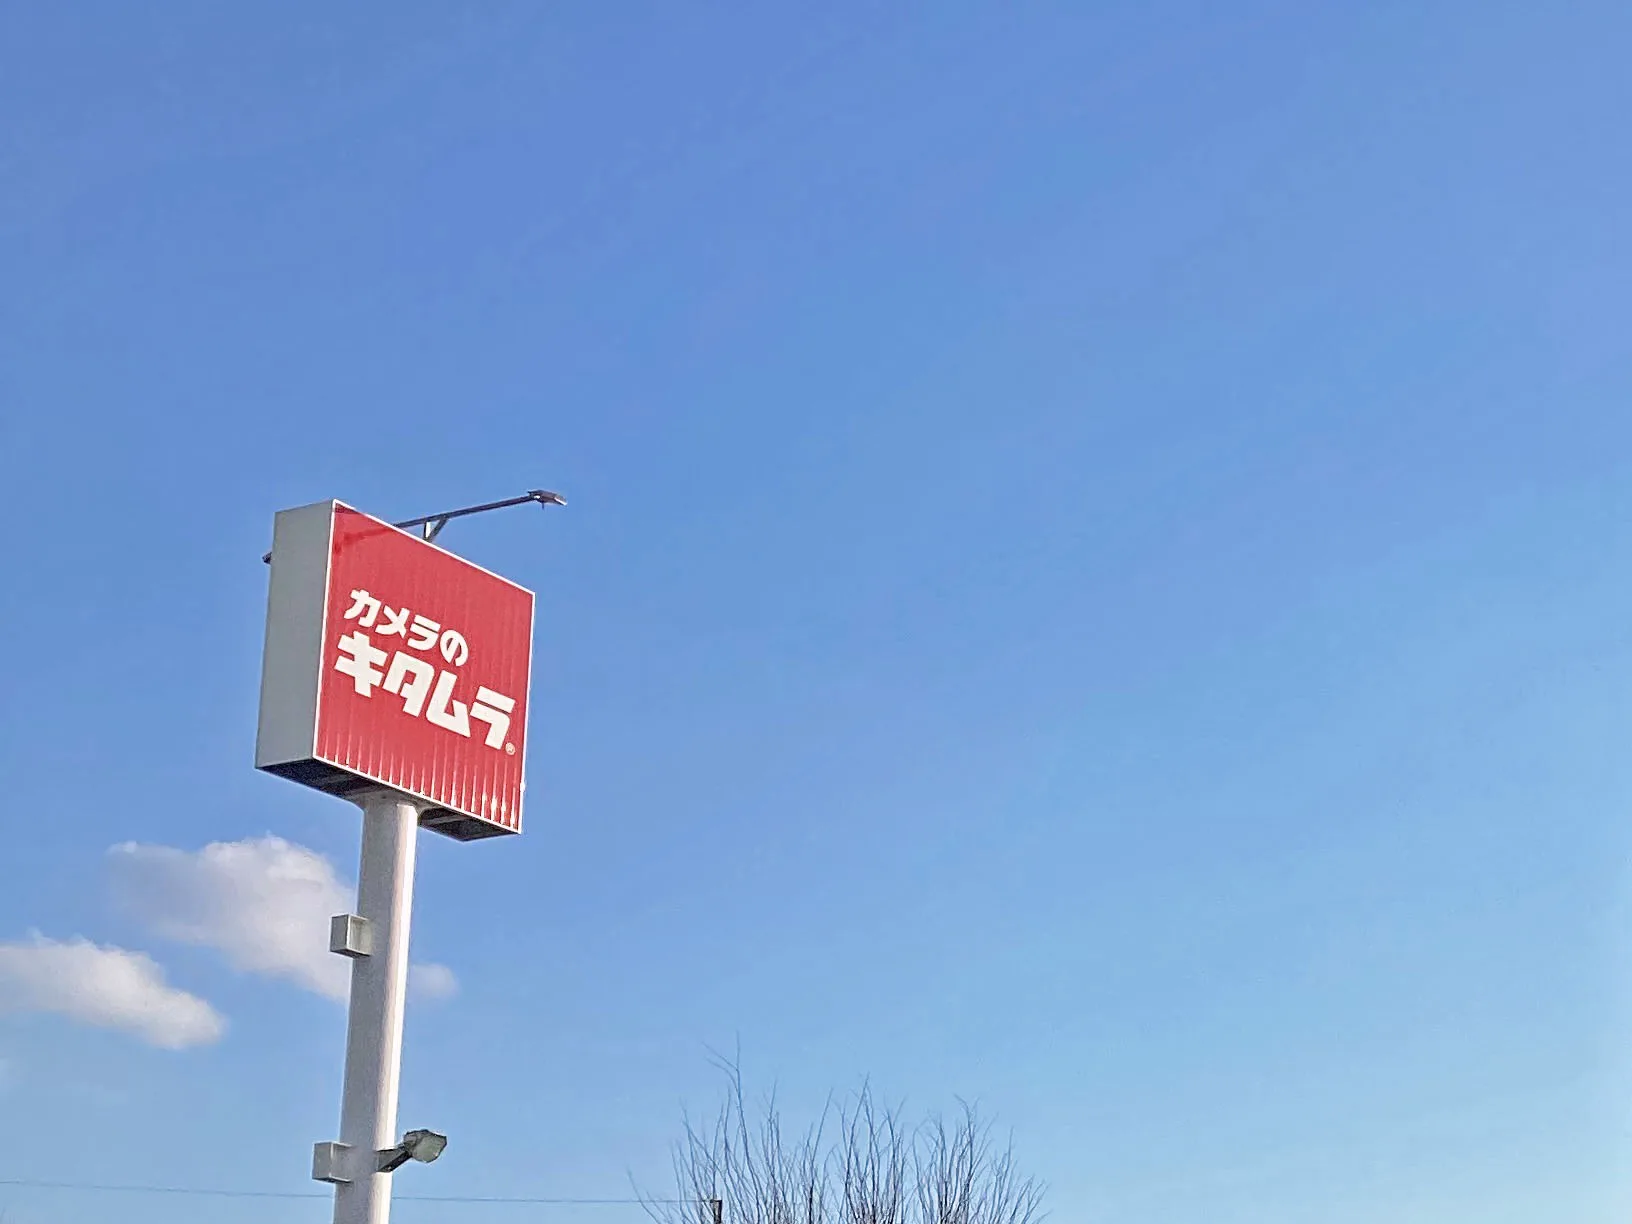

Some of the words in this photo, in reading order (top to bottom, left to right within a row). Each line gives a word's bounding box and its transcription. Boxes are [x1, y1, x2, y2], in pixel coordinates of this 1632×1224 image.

[343, 588, 469, 667] カメラの
[333, 630, 517, 751] キタムラ
